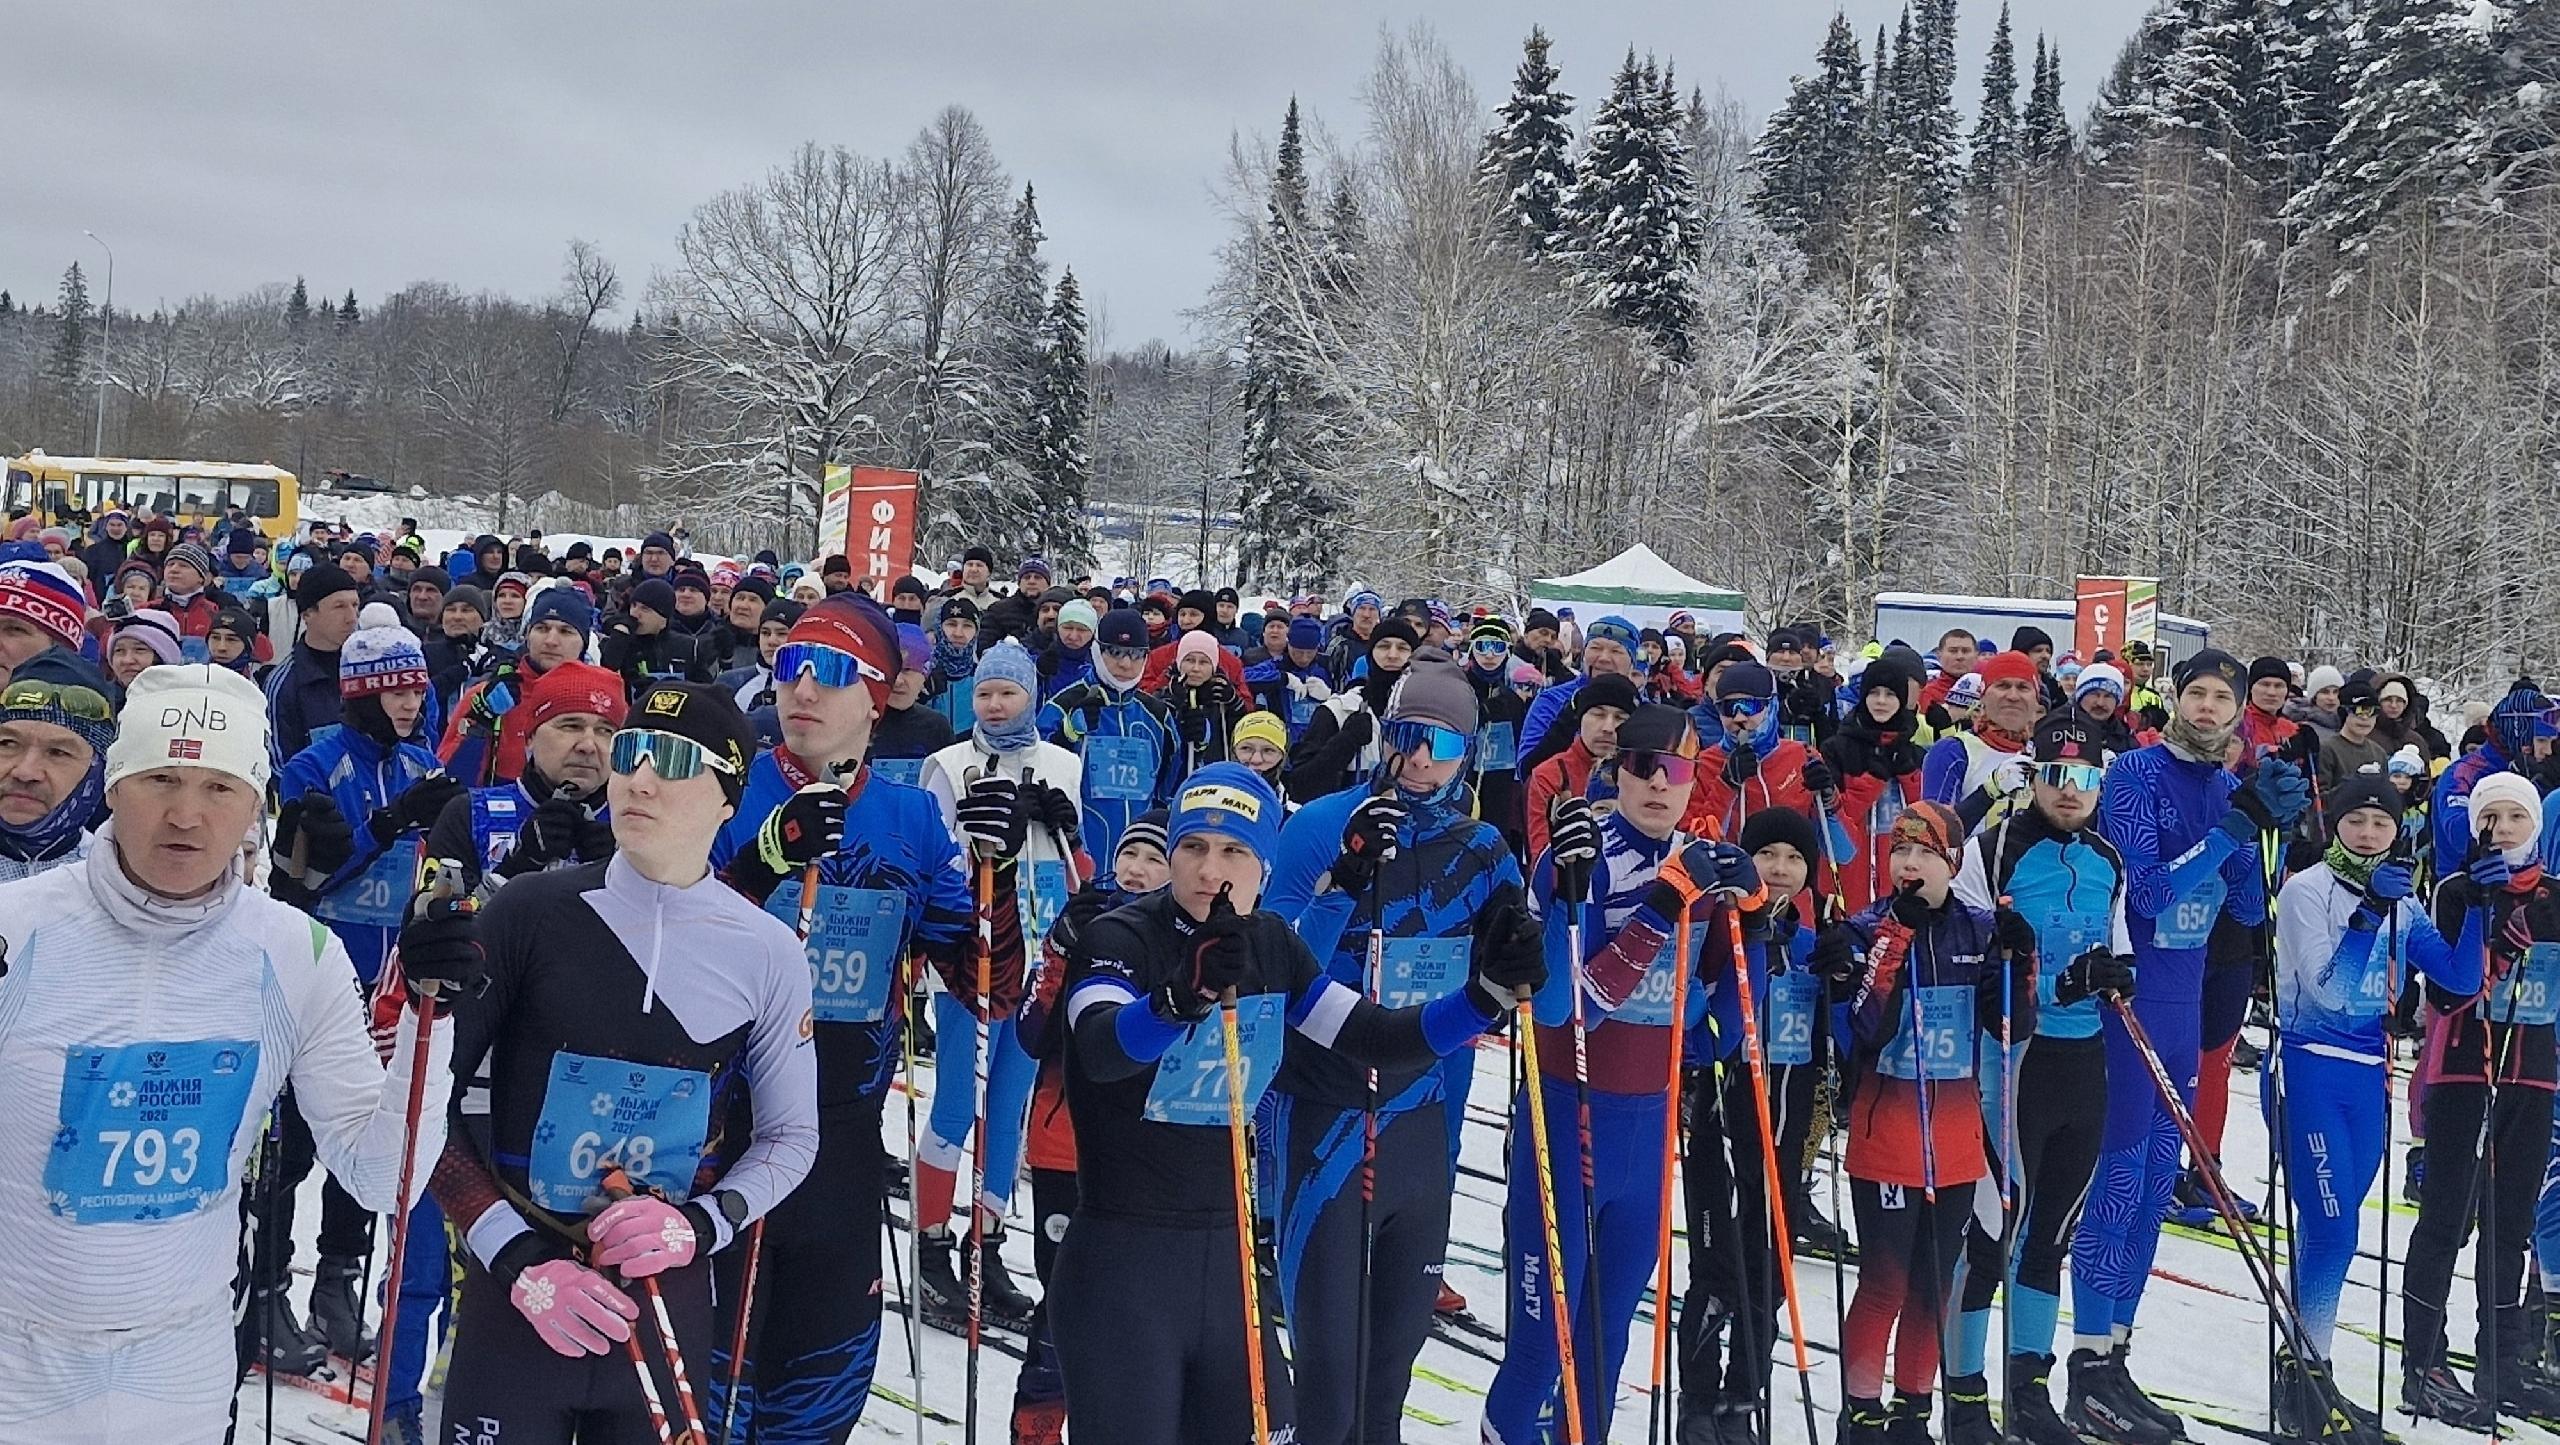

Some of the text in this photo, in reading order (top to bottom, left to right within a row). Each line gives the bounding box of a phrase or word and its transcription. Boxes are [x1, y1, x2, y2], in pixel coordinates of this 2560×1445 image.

[2094, 604, 2109, 651] СТ
[160, 696, 227, 737] DNB
[2052, 724, 2087, 746] DNB
[1108, 764, 1138, 787] 173
[1221, 798, 1256, 816] МАТЧ
[805, 947, 867, 994] 659
[1779, 1012, 1809, 1043] 25
[1903, 1029, 1955, 1058] 215
[138, 1078, 202, 1094] ЛЫЖНЯ
[138, 1093, 202, 1107] РОССИИ
[139, 1109, 169, 1122] 2026
[99, 1128, 201, 1188] 793
[570, 1130, 655, 1180] 648
[2307, 1132, 2340, 1217] SPINE
[80, 1192, 155, 1208] РЕСПУБЛИКА
[2084, 1395, 2135, 1432] SPINE
